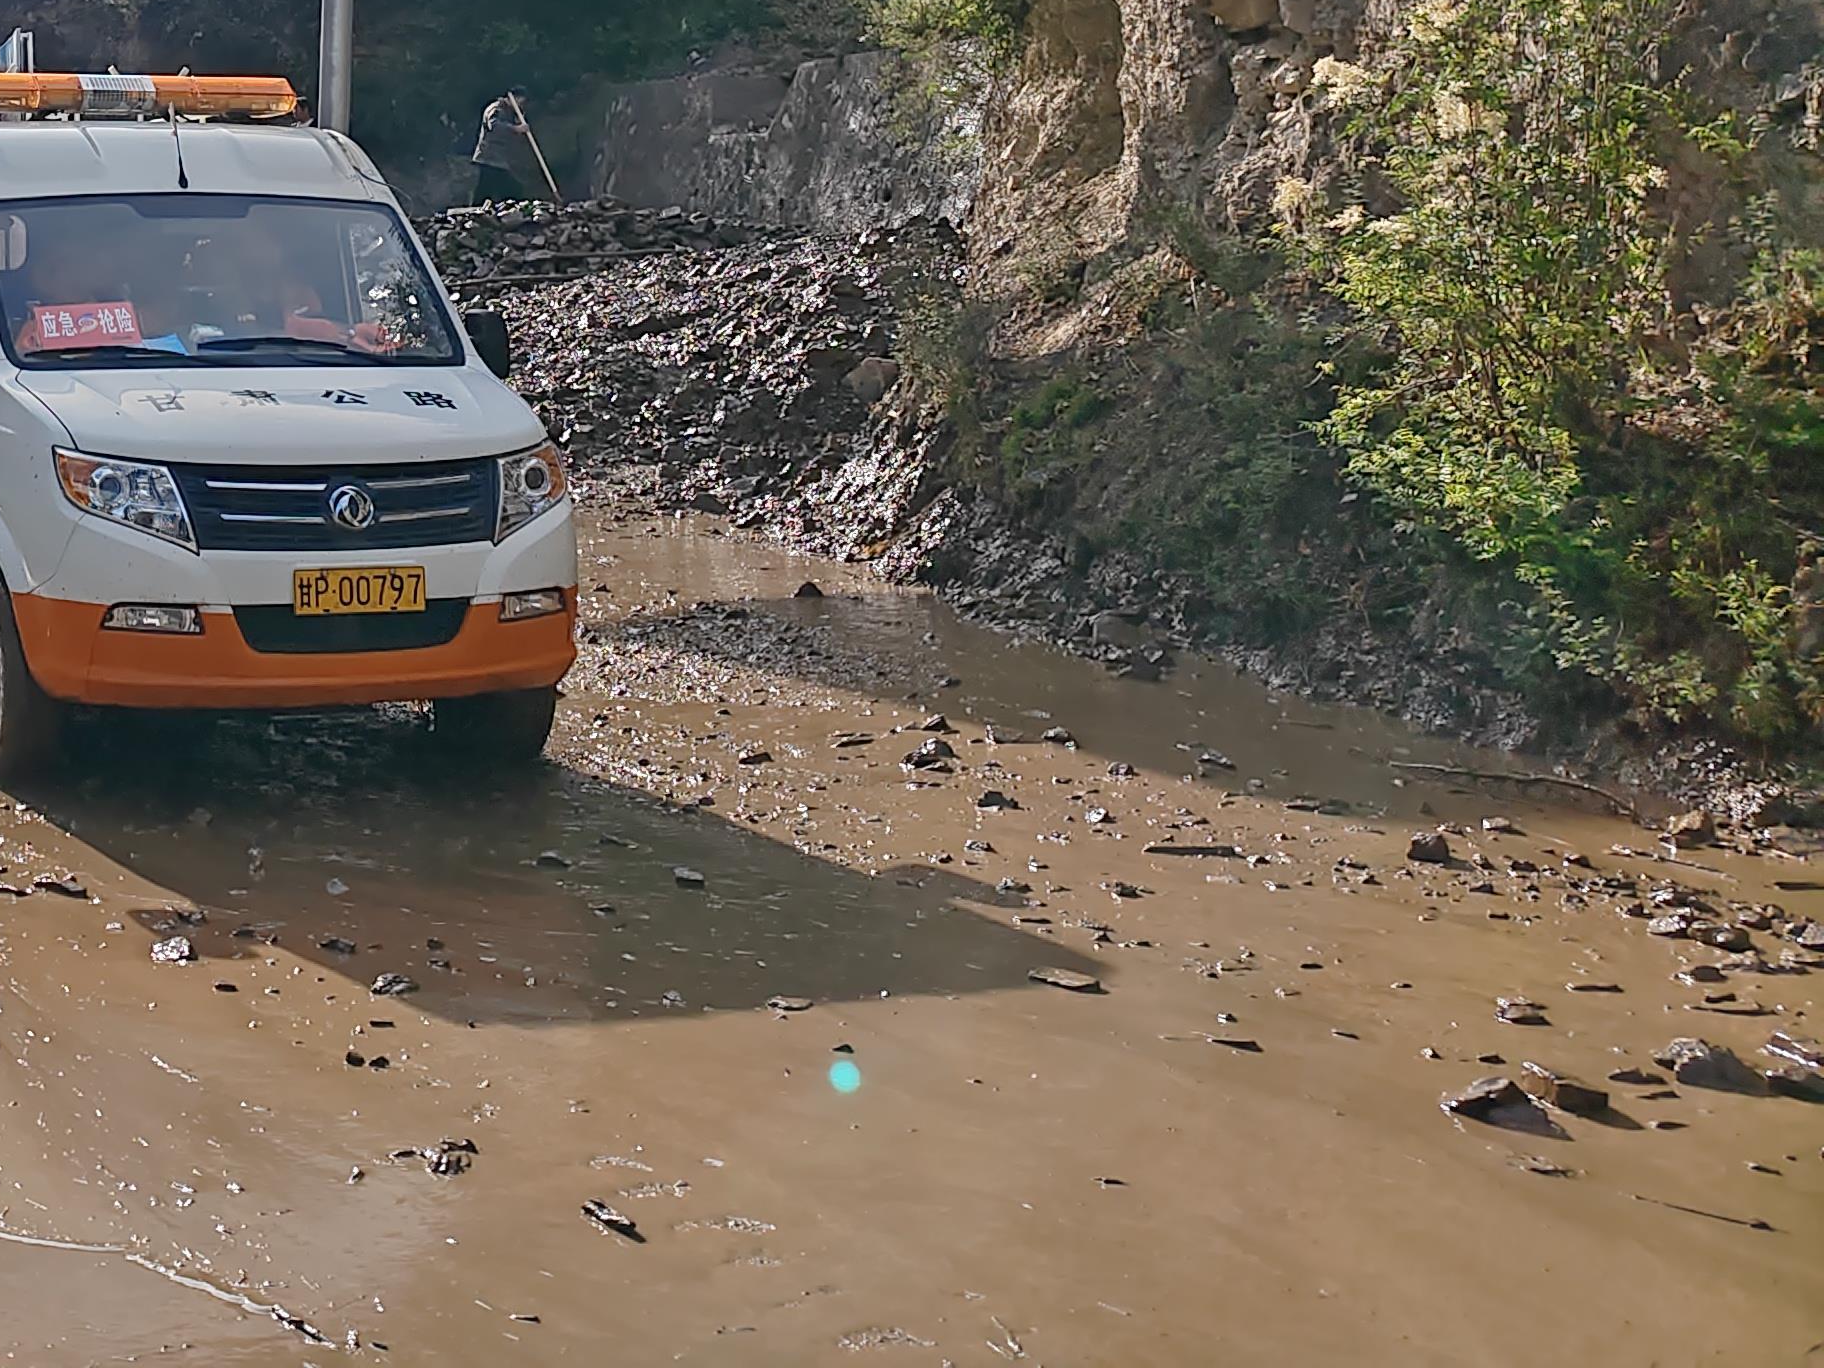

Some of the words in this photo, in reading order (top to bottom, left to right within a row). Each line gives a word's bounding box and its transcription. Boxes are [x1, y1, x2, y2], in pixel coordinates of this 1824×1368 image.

[41, 311, 78, 338] 应急
[97, 307, 135, 334] 抢险
[138, 388, 458, 413] 甘肃公路
